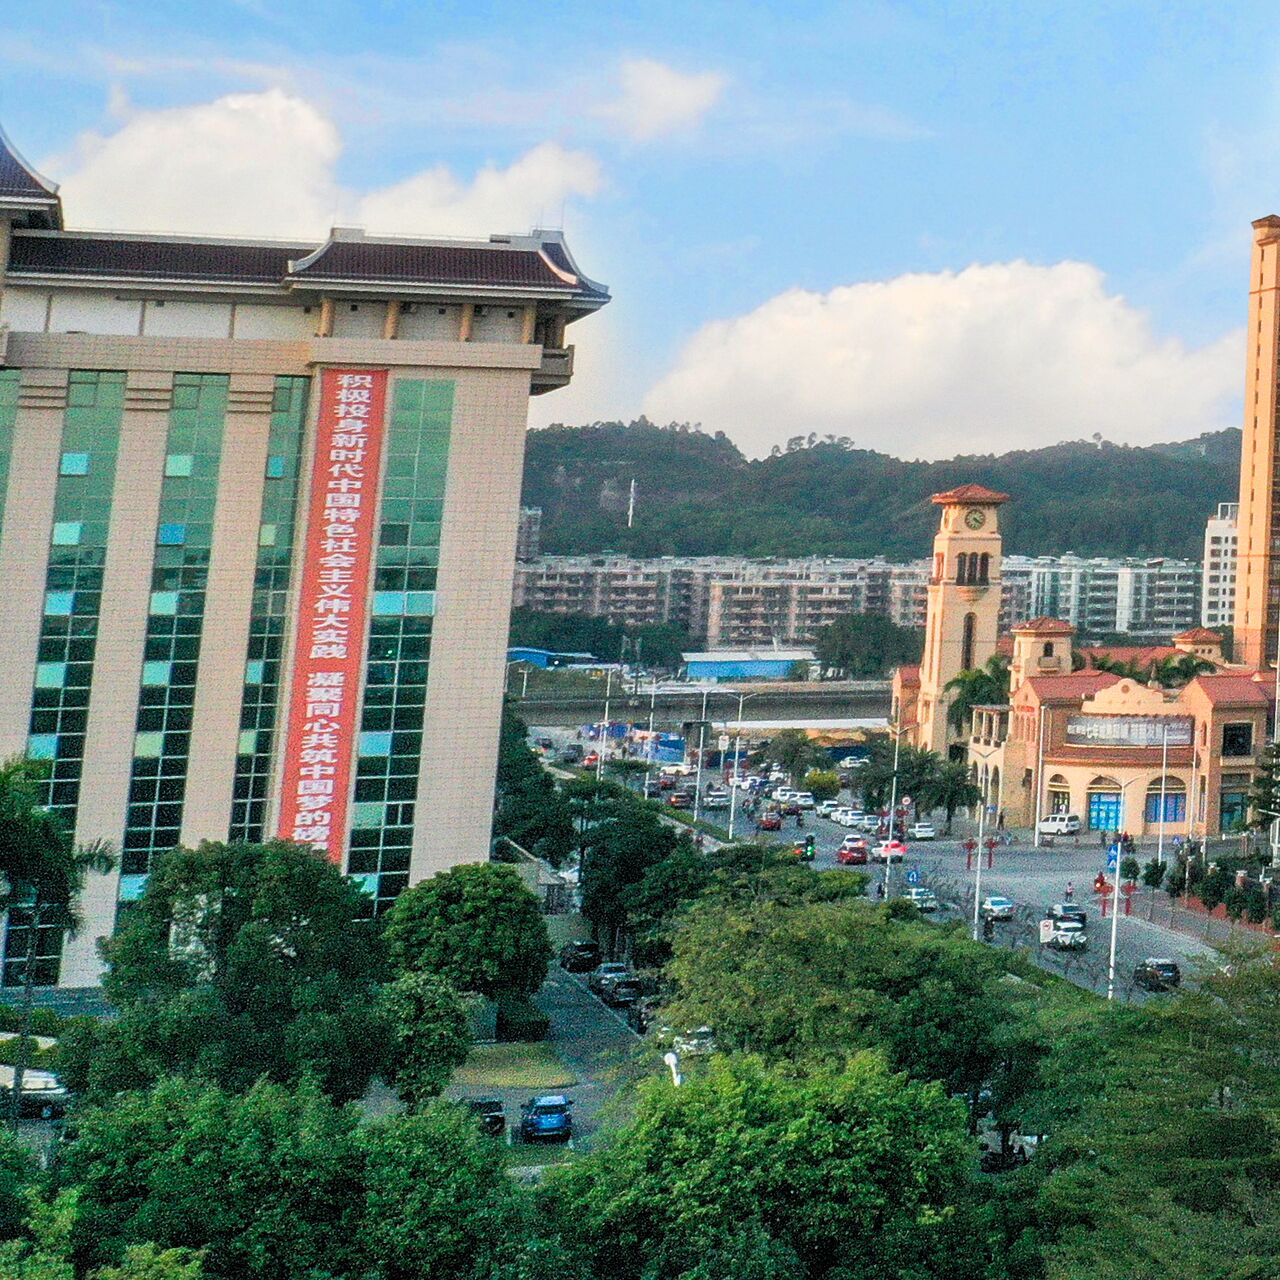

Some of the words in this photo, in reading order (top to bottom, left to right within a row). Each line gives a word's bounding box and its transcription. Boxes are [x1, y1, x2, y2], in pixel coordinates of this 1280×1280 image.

[308, 373, 374, 660] 积极投身新时代中国特色社会主义伟大实践
